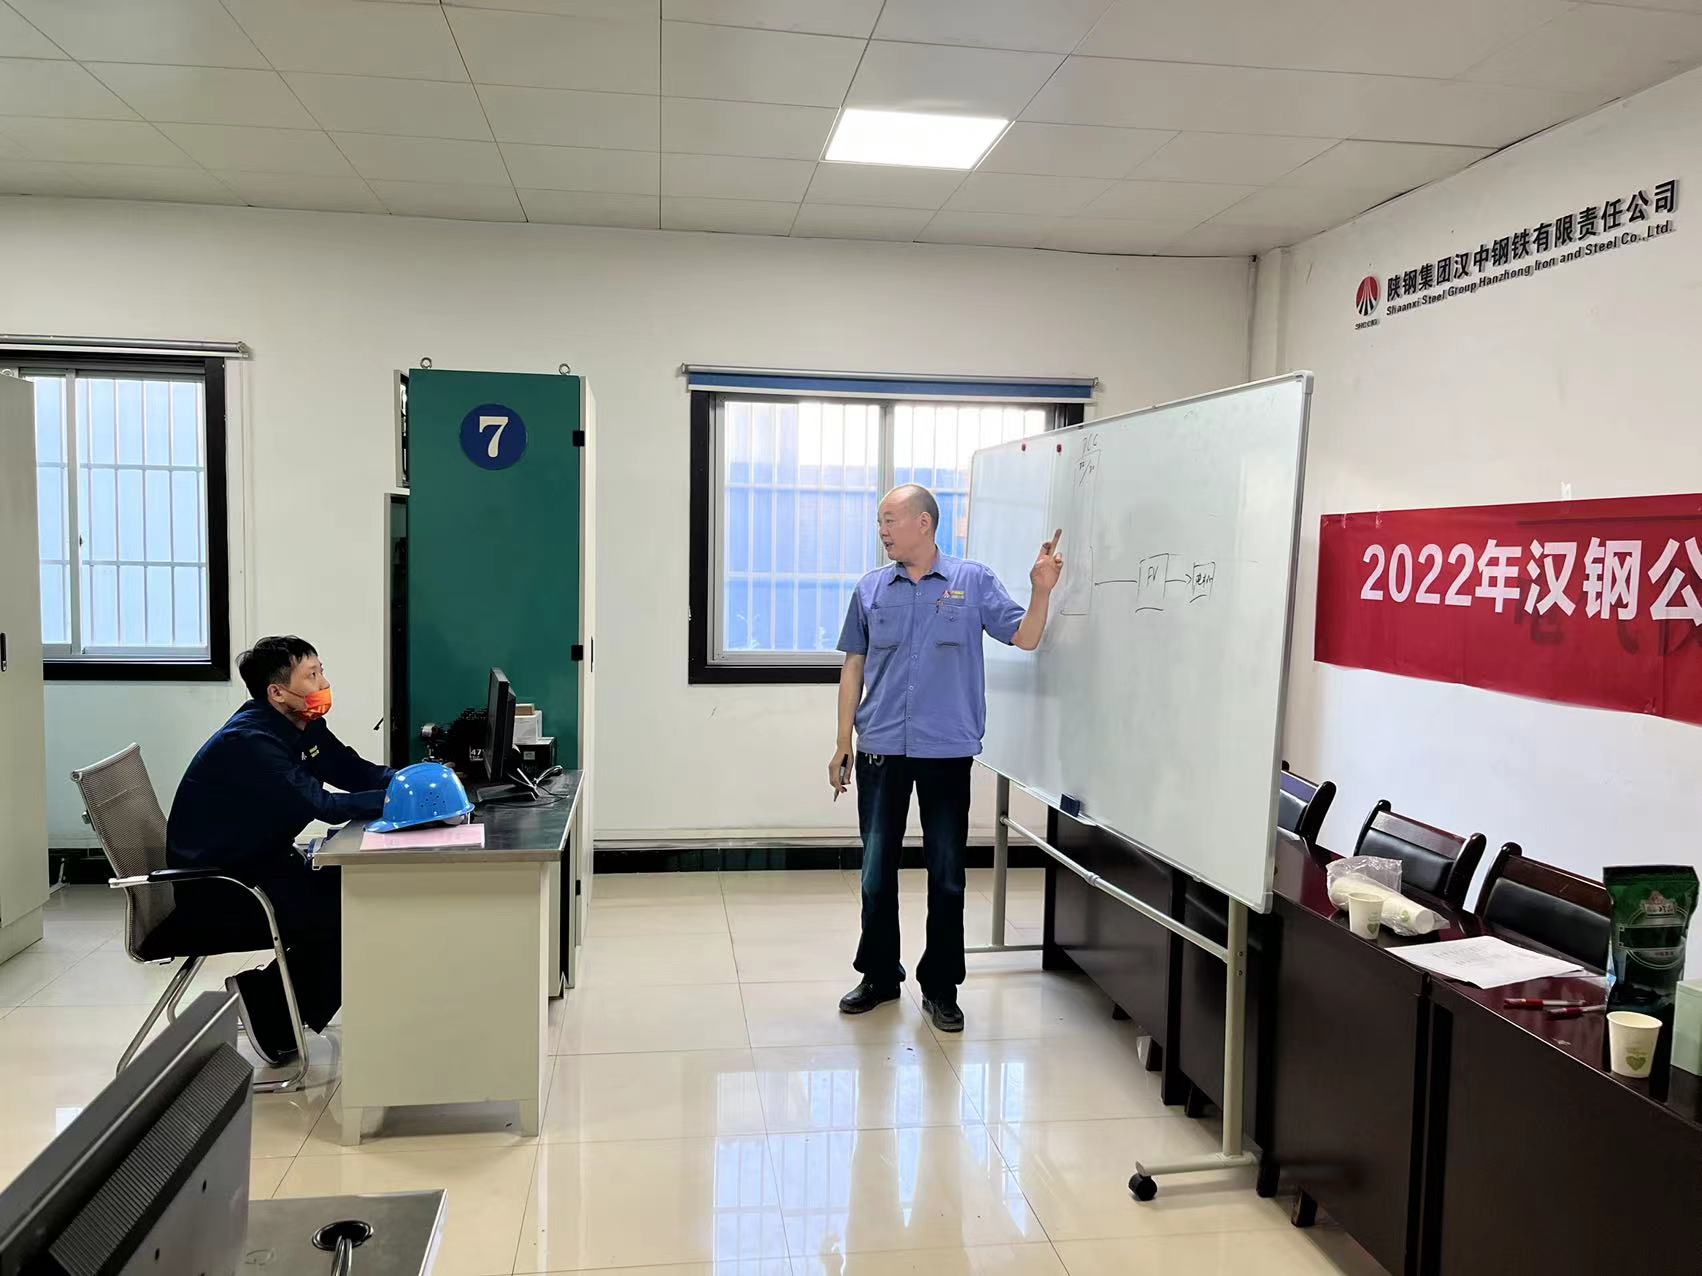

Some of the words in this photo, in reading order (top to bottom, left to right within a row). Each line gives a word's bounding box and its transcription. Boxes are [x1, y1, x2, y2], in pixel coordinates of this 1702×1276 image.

[1386, 179, 1677, 302] 陕钢集团汉中钢铁有限责任公司
[1386, 298, 1420, 315] Shaanxi
[1421, 289, 1446, 305] Steel
[1447, 281, 1476, 297] Group
[1479, 265, 1531, 288] Hanzhong
[1534, 257, 1556, 271] Iron
[1559, 246, 1582, 263] and
[1585, 236, 1617, 256] Steel
[479, 415, 509, 458] 7
[1360, 537, 1702, 627] 2022年汉钢公
